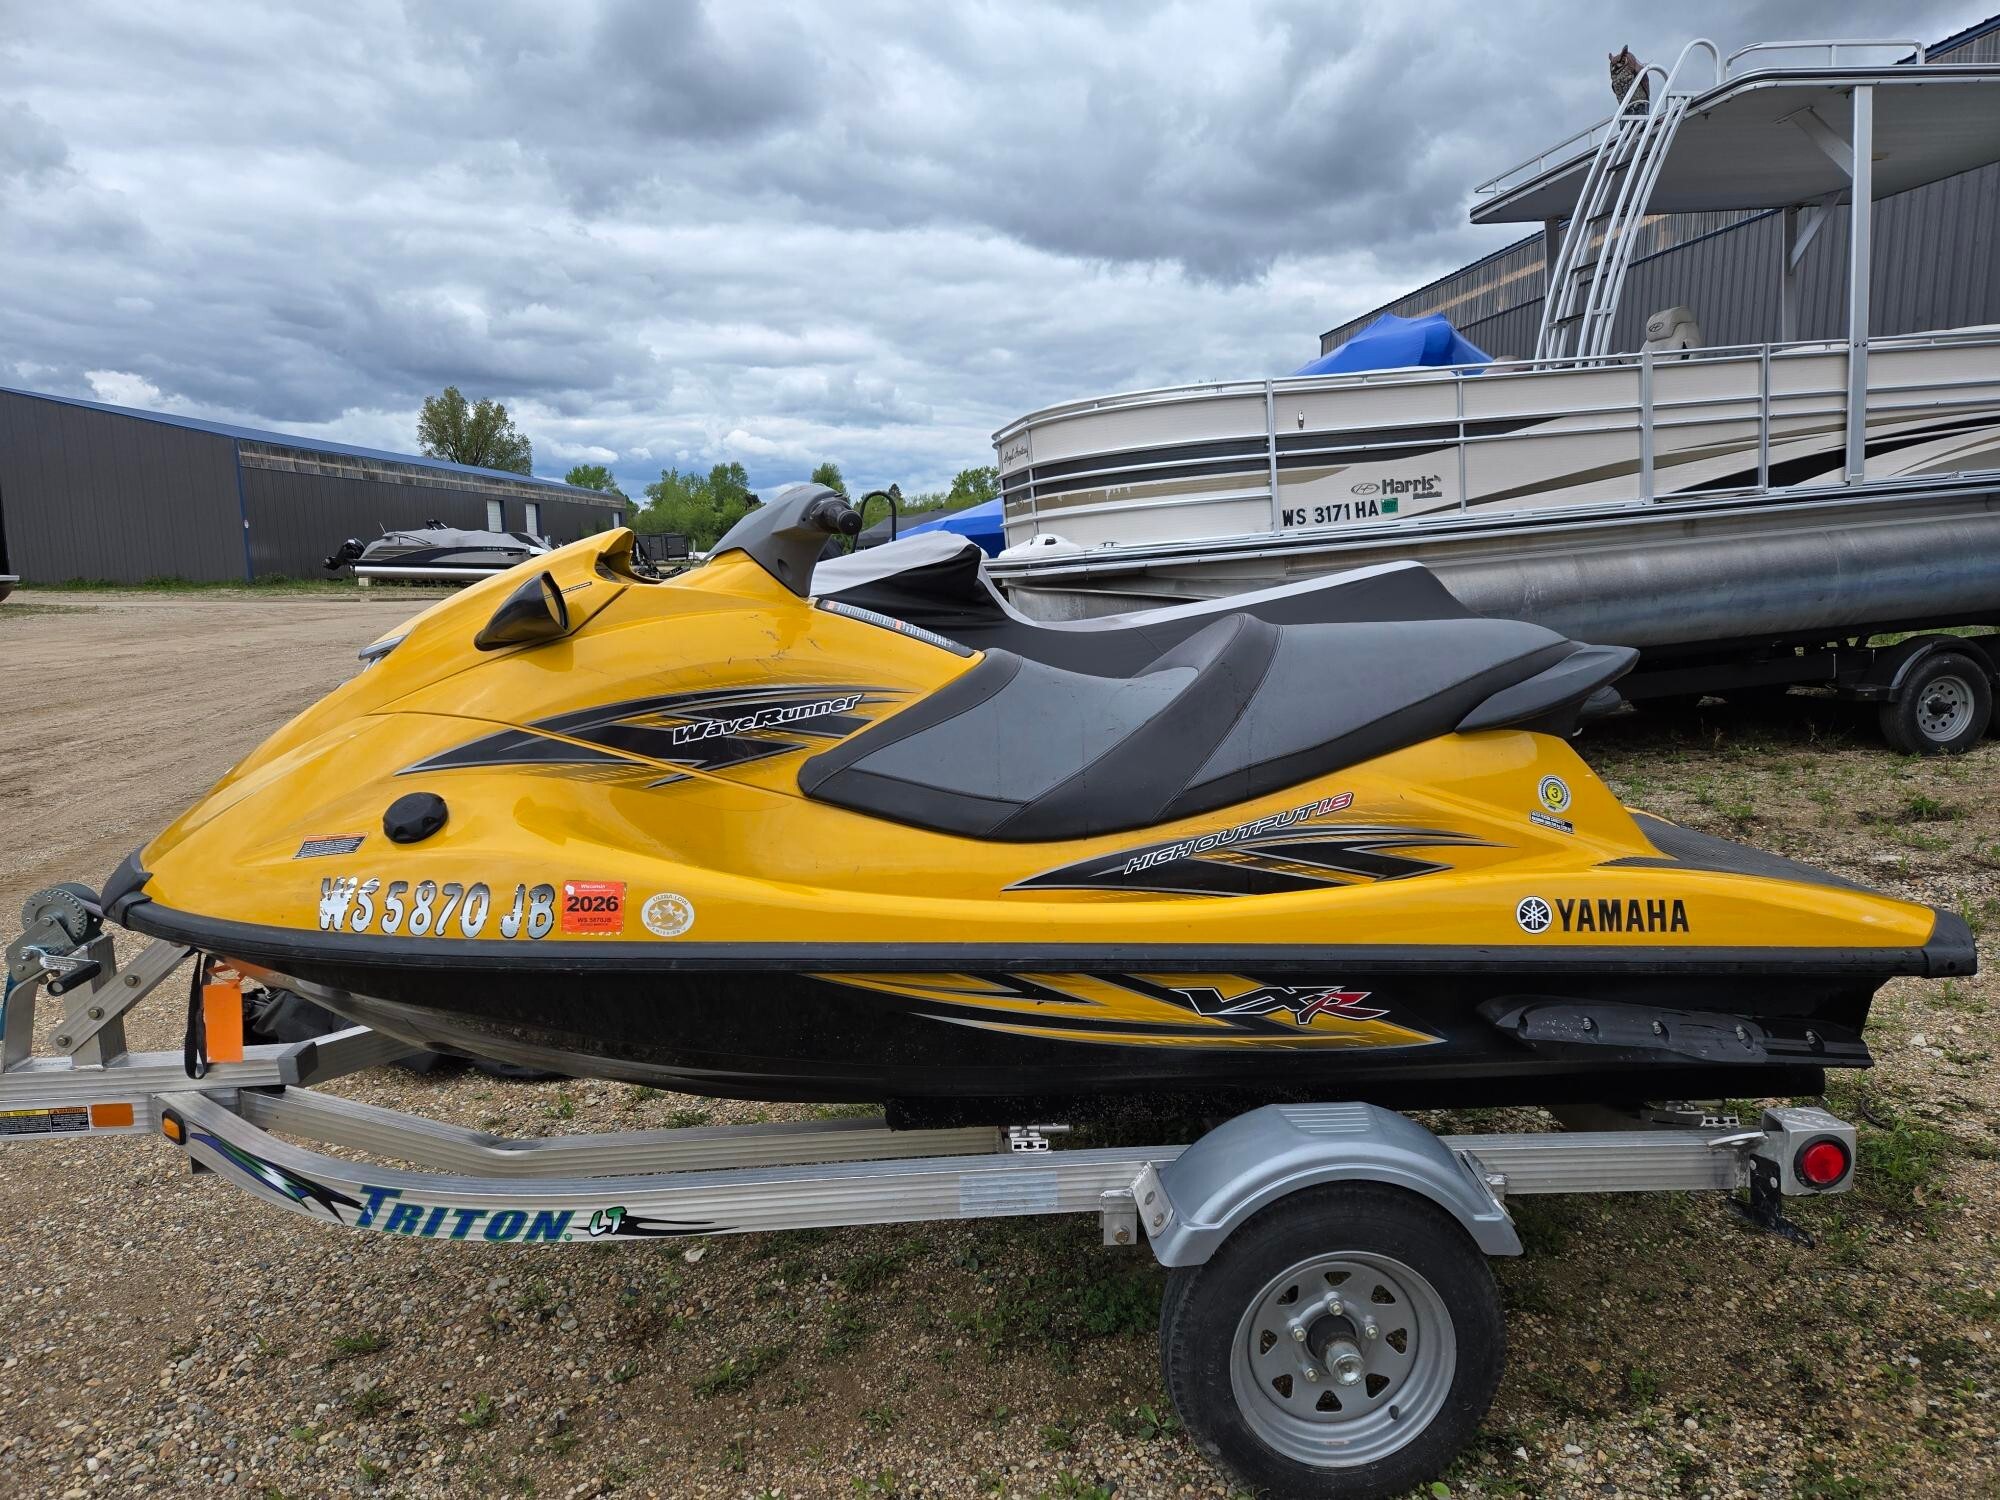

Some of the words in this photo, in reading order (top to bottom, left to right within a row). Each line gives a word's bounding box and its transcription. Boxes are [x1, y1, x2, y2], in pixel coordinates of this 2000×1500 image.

[1382, 476, 1434, 495] Harris
[1283, 508, 1306, 526] WS
[1314, 503, 1350, 523] 3171
[1355, 500, 1379, 518] HA
[673, 693, 864, 745] WaveRunner
[1124, 840, 1196, 875] HIGH
[1195, 802, 1318, 852] OUTPUT
[1317, 792, 1353, 815] 1.8
[320, 877, 380, 933] WS
[381, 880, 491, 939] 5870
[500, 883, 556, 939] JB
[566, 895, 619, 912] 2026
[1555, 899, 1689, 932] YAMAHA
[589, 1206, 627, 1237] LT
